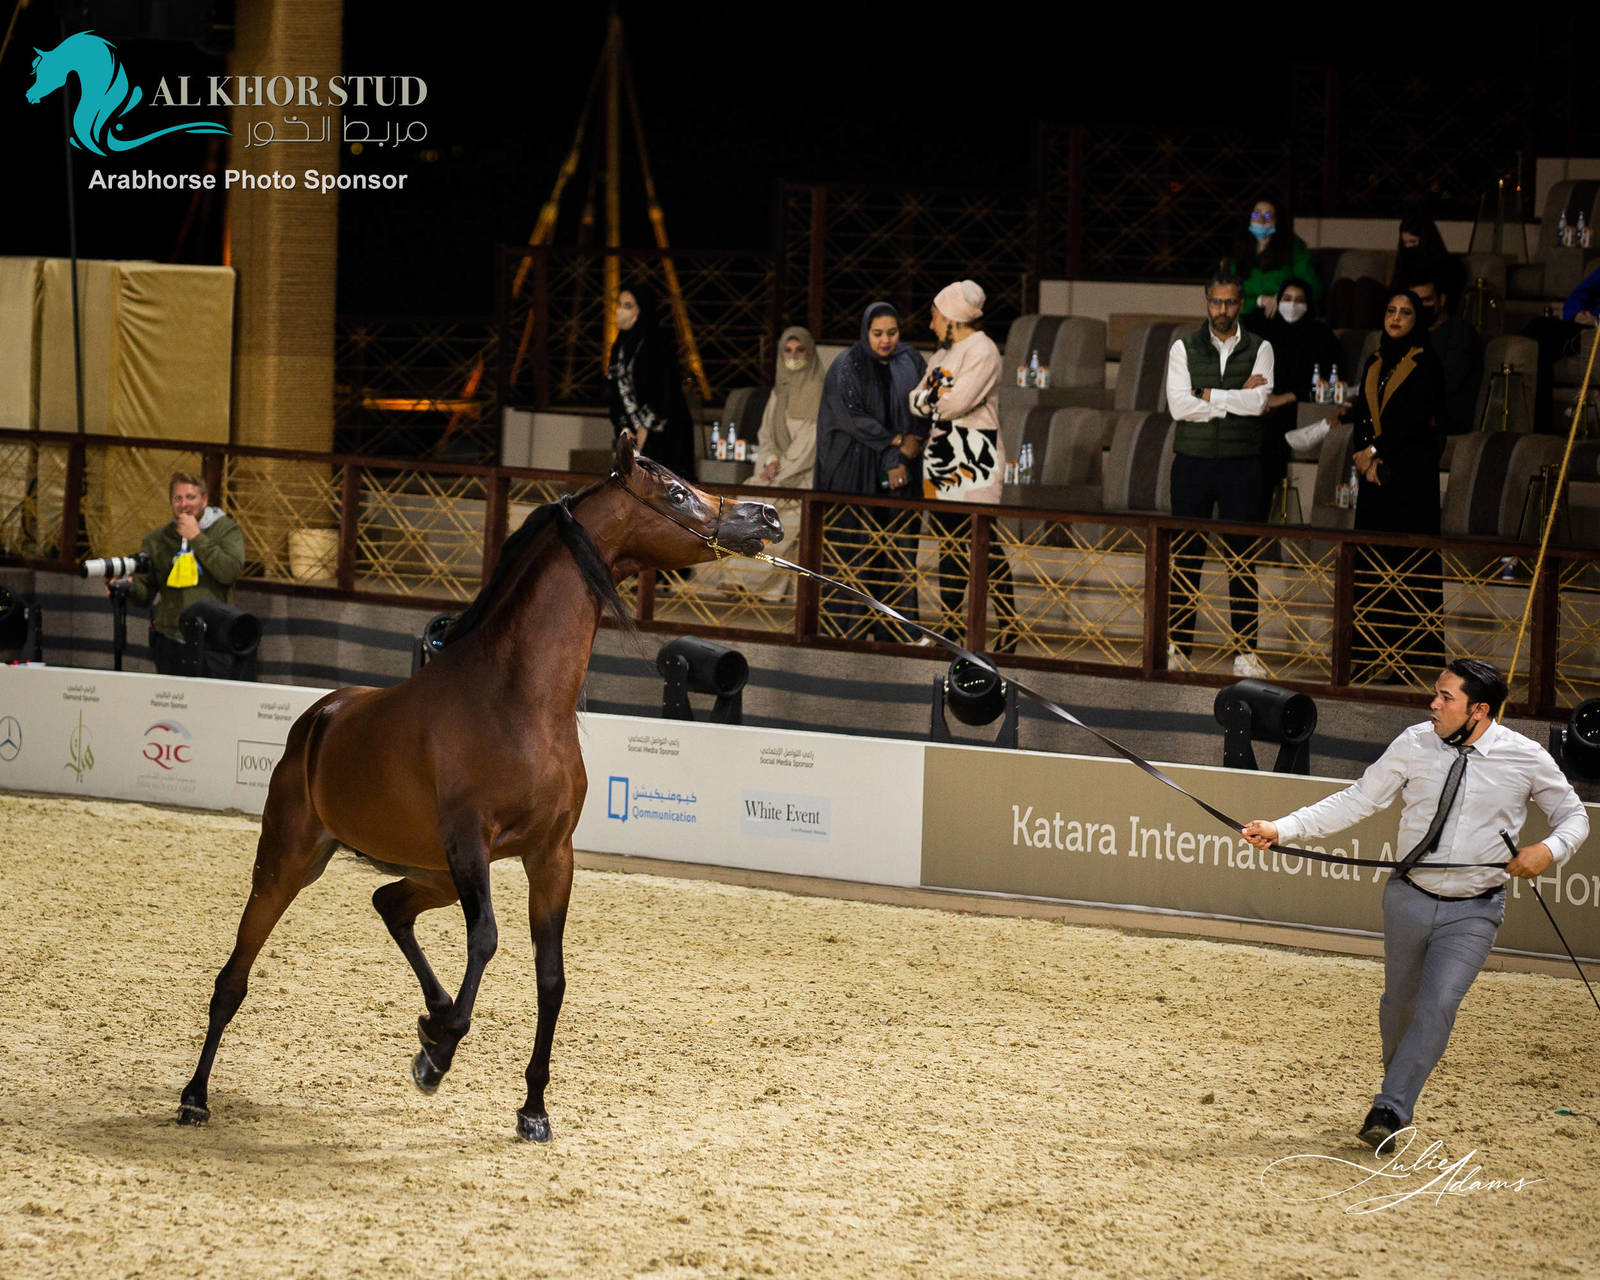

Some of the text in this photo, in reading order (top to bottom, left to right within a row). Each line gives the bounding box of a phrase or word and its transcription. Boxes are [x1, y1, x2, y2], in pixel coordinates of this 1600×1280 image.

[142, 741, 192, 770] QIC
[627, 744, 680, 757] Social Media Sponsor
[240, 755, 273, 772] JOVOY
[760, 756, 814, 768] Social Media Sponsor
[632, 805, 697, 823] Qommunication
[745, 800, 821, 825] White Event
[1012, 804, 1118, 856] Katara
